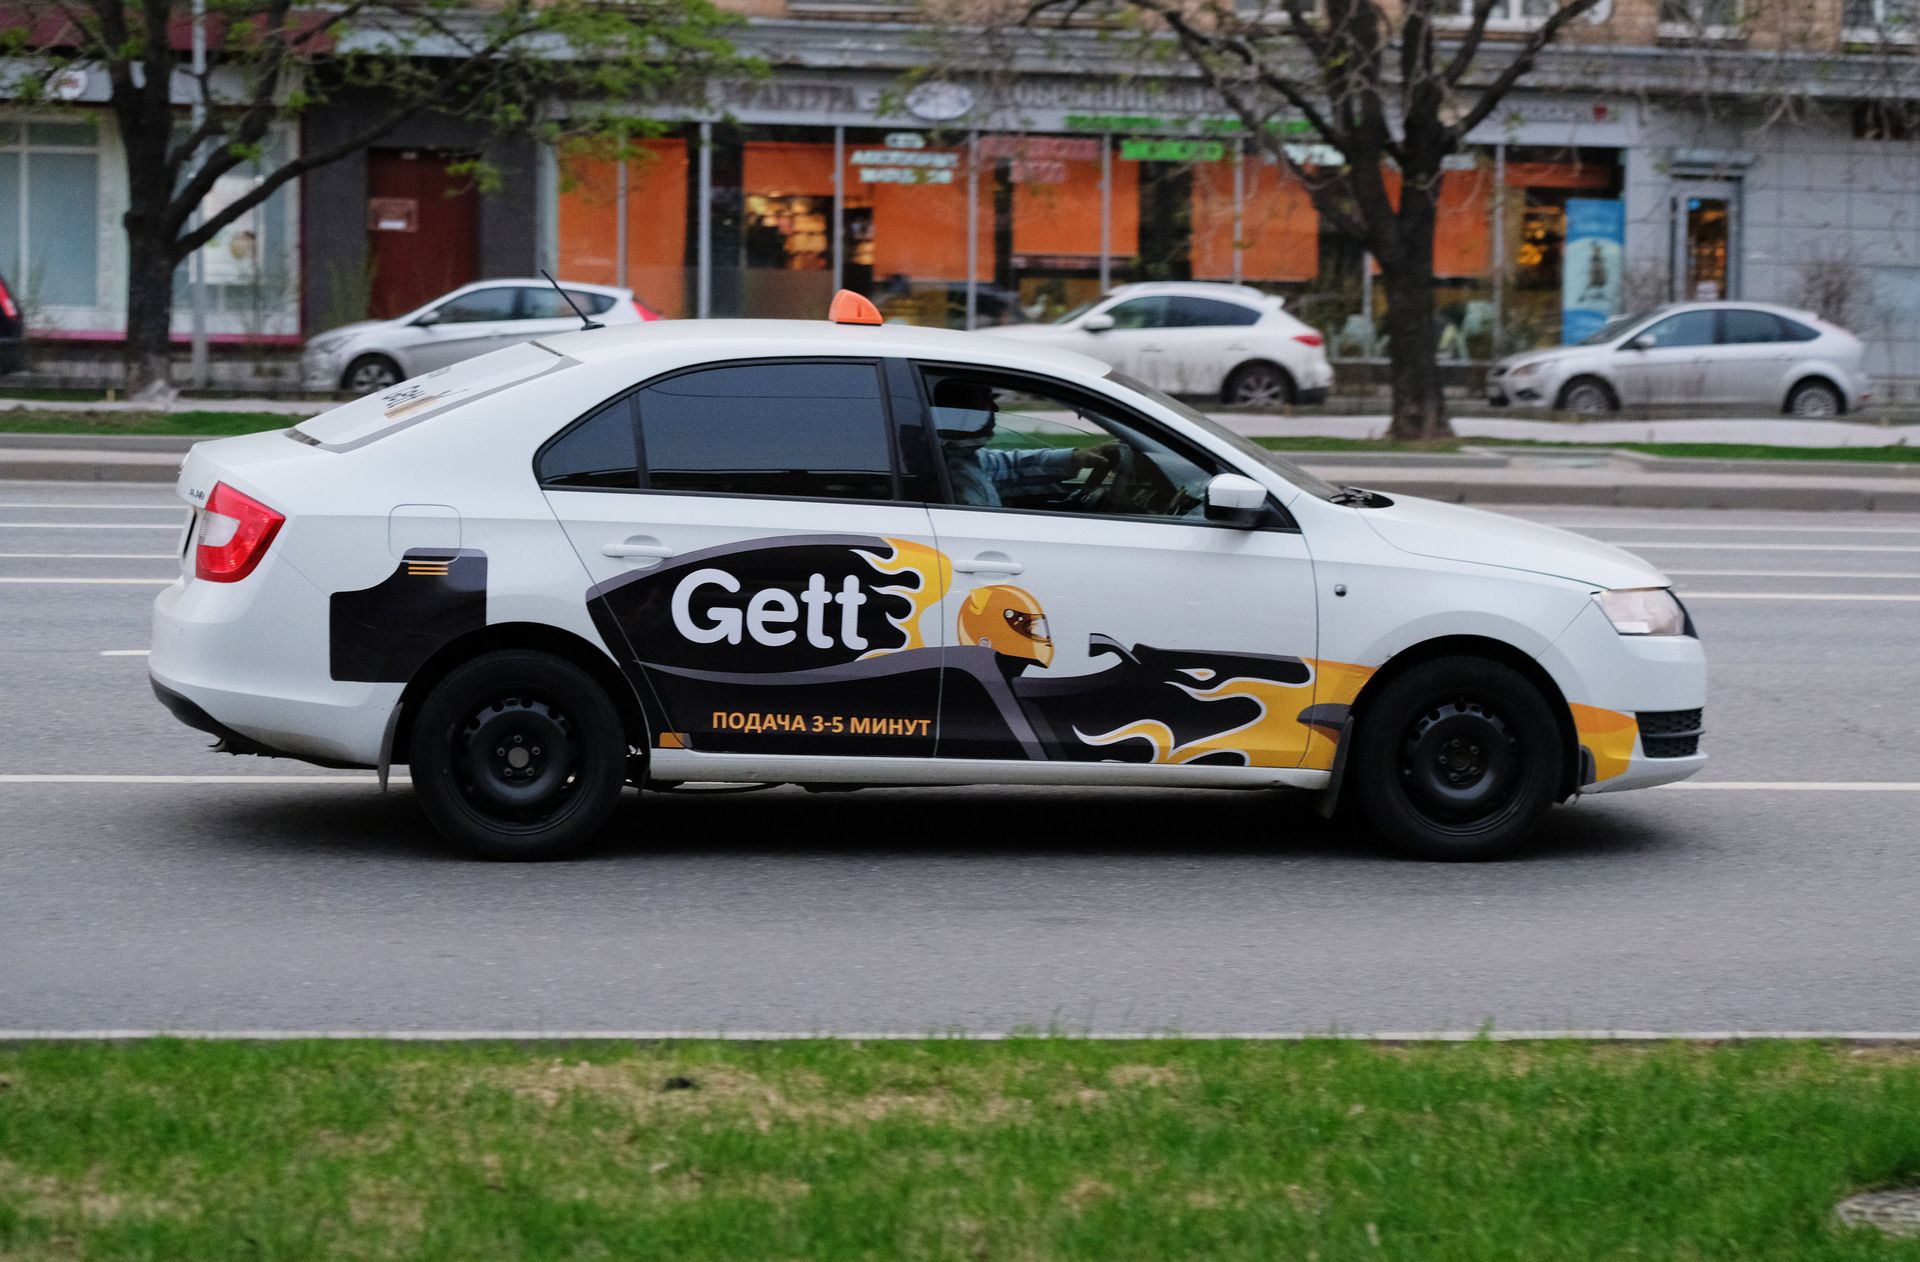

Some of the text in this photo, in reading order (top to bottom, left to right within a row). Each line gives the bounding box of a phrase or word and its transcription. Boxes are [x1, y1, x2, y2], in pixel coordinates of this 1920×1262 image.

[671, 568, 869, 651] Gett
[712, 711, 931, 736] ПОДАЧА 3-5 МИНУТ
